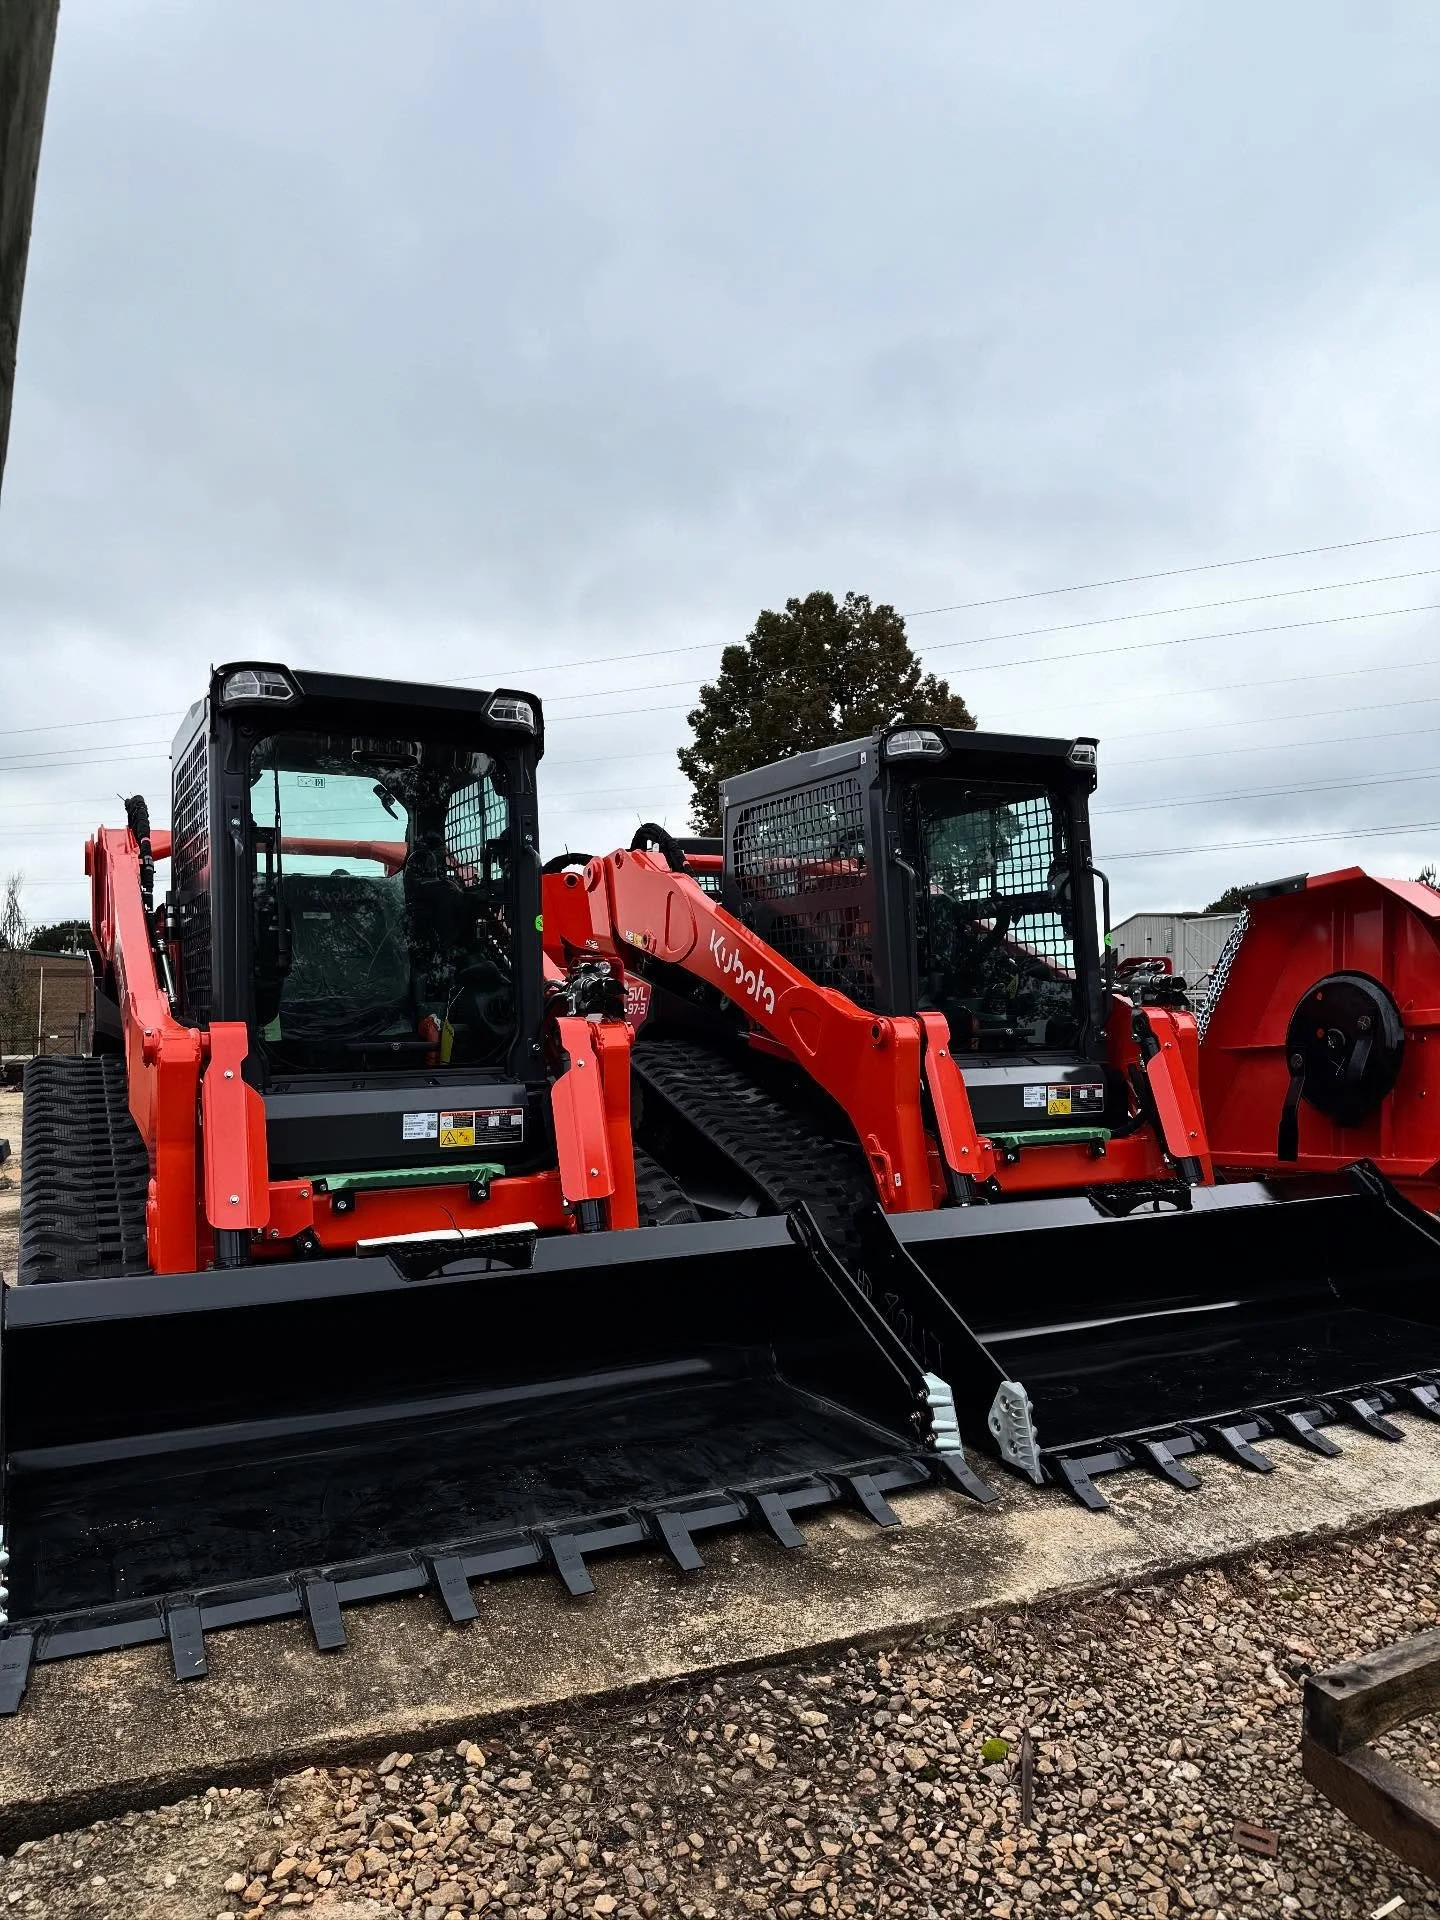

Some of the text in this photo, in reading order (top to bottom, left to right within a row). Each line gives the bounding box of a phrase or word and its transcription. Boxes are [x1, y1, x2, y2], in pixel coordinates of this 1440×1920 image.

[709, 928, 775, 1014] Kubota
[627, 986, 648, 1002] SVL
[627, 1003, 646, 1015] 97-3
